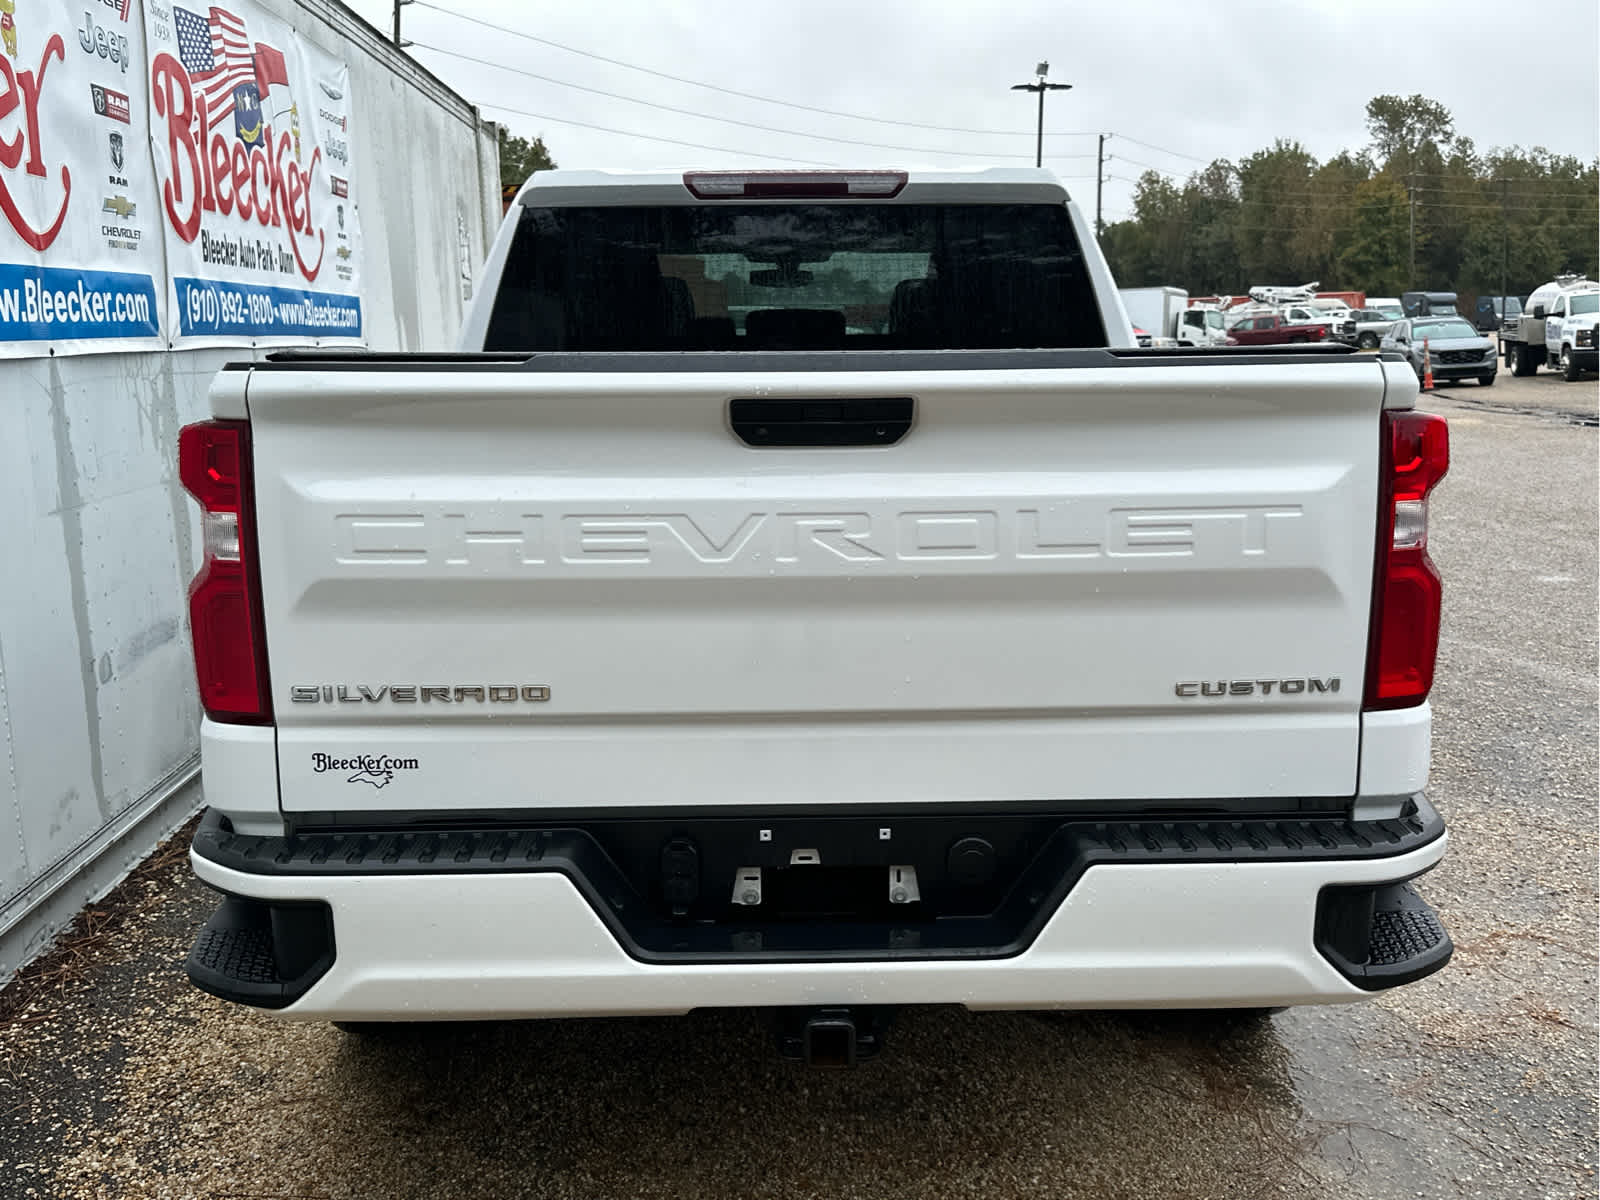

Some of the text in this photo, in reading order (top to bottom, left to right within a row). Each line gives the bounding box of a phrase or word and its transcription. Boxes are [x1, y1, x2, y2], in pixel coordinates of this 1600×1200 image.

[78, 11, 129, 73] Jeep
[108, 175, 129, 187] RAM
[152, 52, 325, 282] Bleecker
[101, 225, 142, 241] CHEVROLET
[201, 228, 295, 274] Bleecker Auto Park Dunn
[186, 283, 358, 330] (910) 892-1800 www.Bleecker.com
[335, 503, 1304, 566] CHEVROLET
[290, 684, 552, 703] SILVERADO
[1174, 677, 1342, 697] CUSTOM
